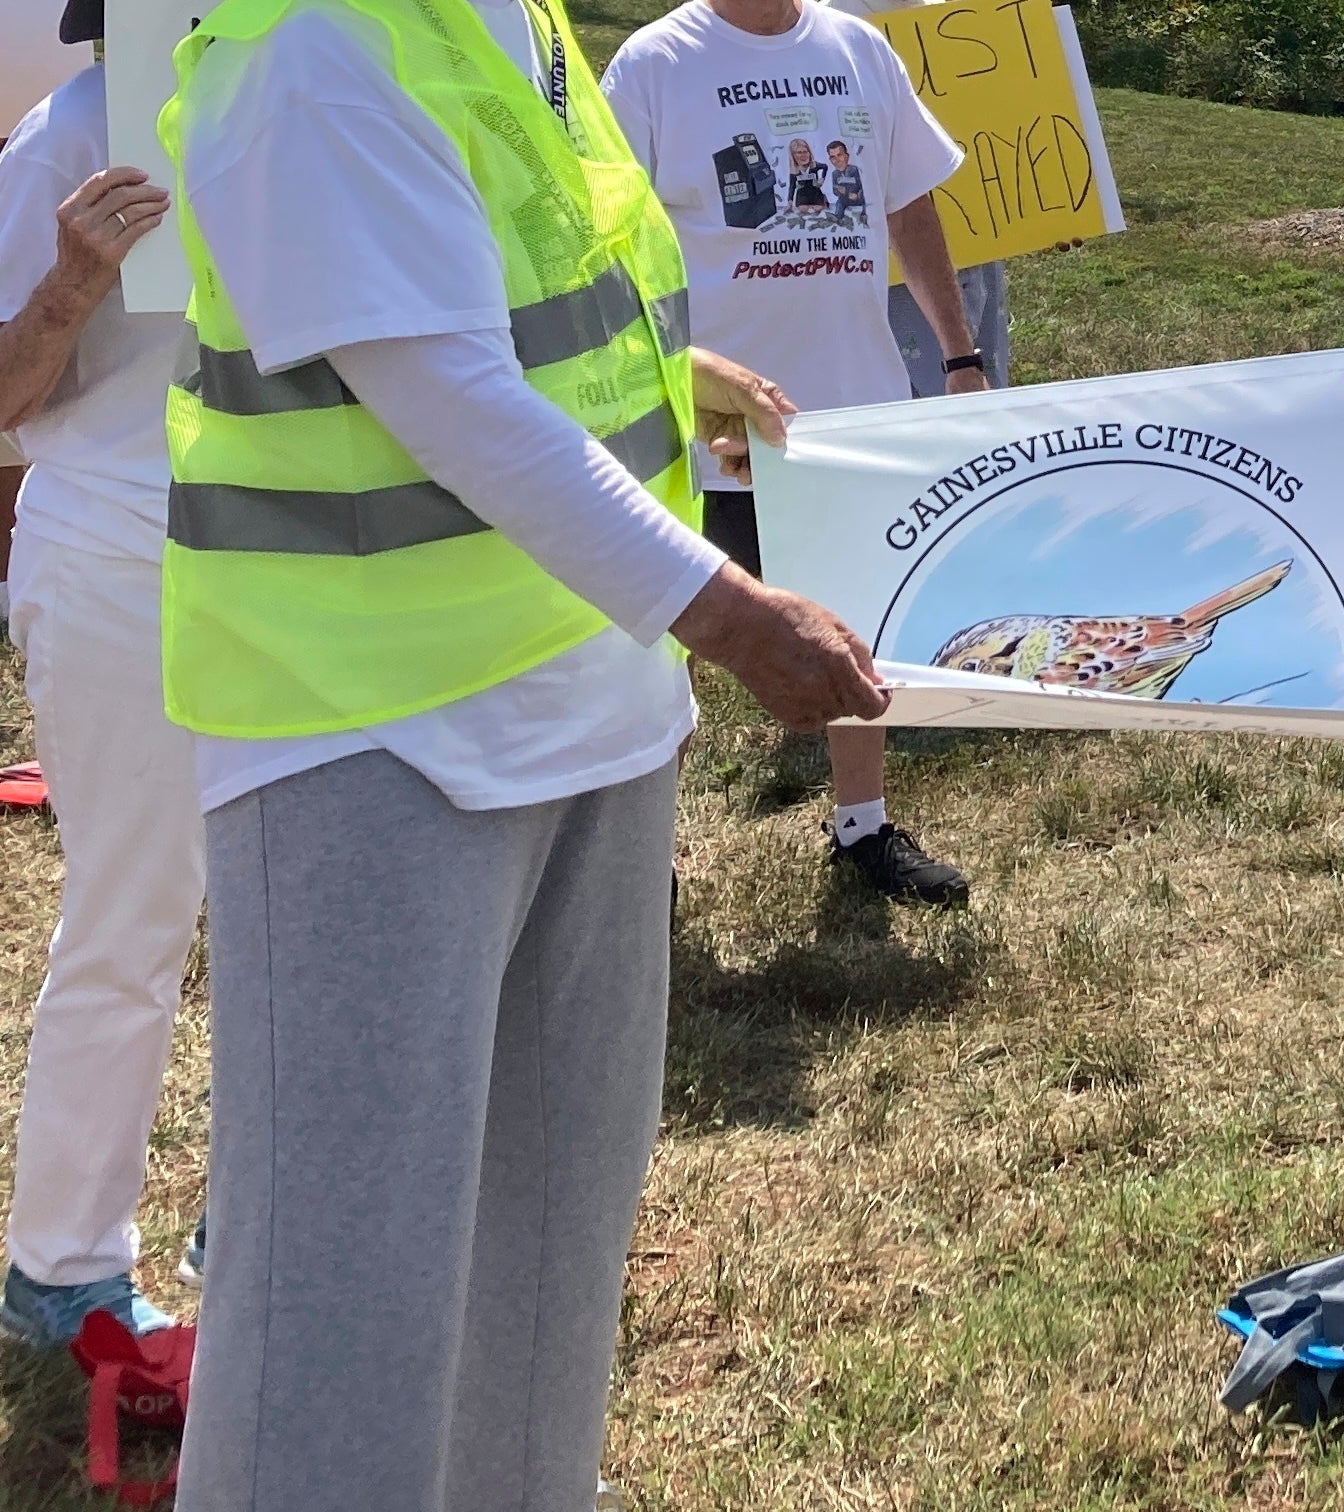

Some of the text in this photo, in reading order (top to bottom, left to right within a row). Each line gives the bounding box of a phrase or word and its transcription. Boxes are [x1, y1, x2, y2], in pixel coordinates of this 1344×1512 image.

[551, 33, 567, 120] VOLUNTE
[717, 75, 850, 108] RECALL NOW!
[752, 238, 801, 256] FOLLOW
[807, 236, 828, 252] THE
[885, 422, 1305, 552] GAINESVILLE CITIZENS
